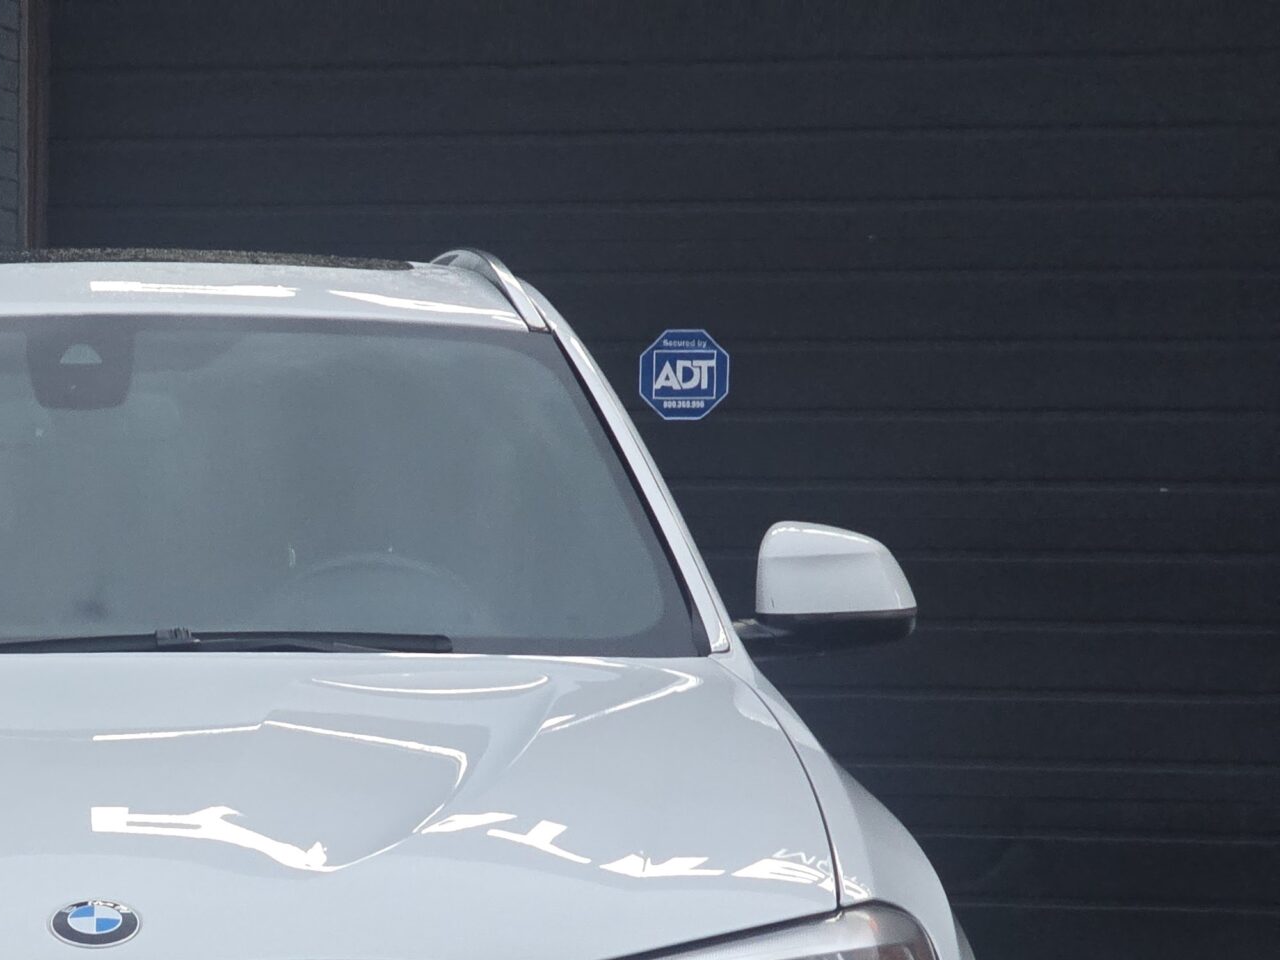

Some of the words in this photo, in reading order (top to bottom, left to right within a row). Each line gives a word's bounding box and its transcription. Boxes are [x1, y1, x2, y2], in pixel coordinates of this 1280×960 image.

[662, 339, 696, 347] Secured
[697, 339, 707, 348] by
[655, 359, 716, 390] ADT
